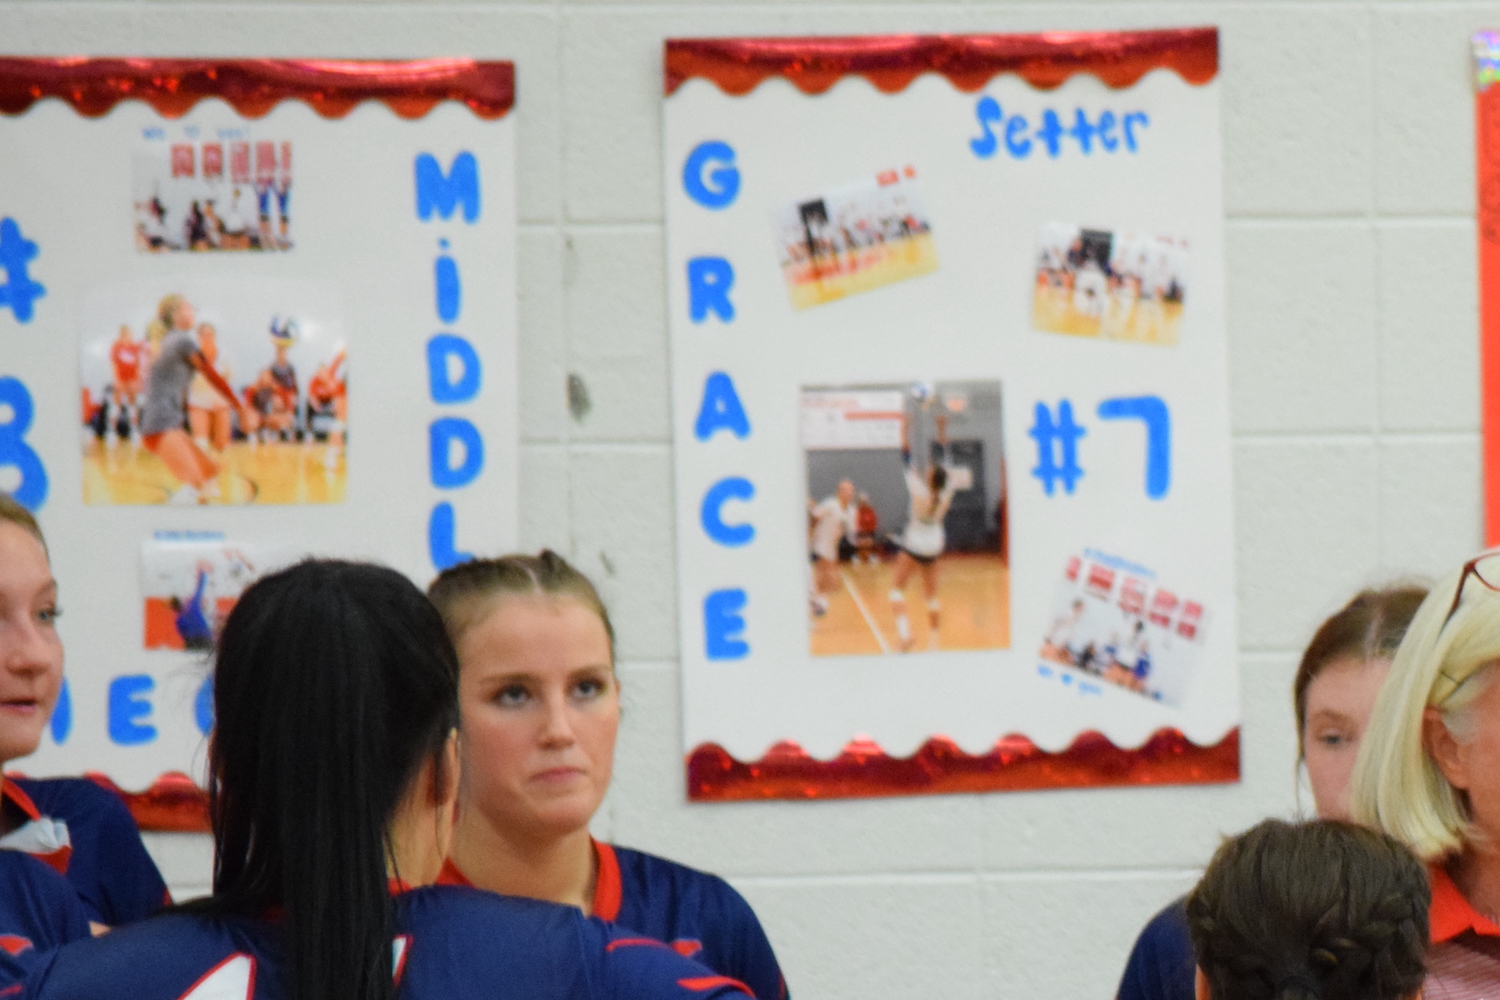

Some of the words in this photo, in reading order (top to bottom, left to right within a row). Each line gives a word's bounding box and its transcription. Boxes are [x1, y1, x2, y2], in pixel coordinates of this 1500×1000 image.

[969, 97, 1150, 158] Setter
[683, 141, 756, 660] GRACE
[1030, 395, 1171, 499] #7
